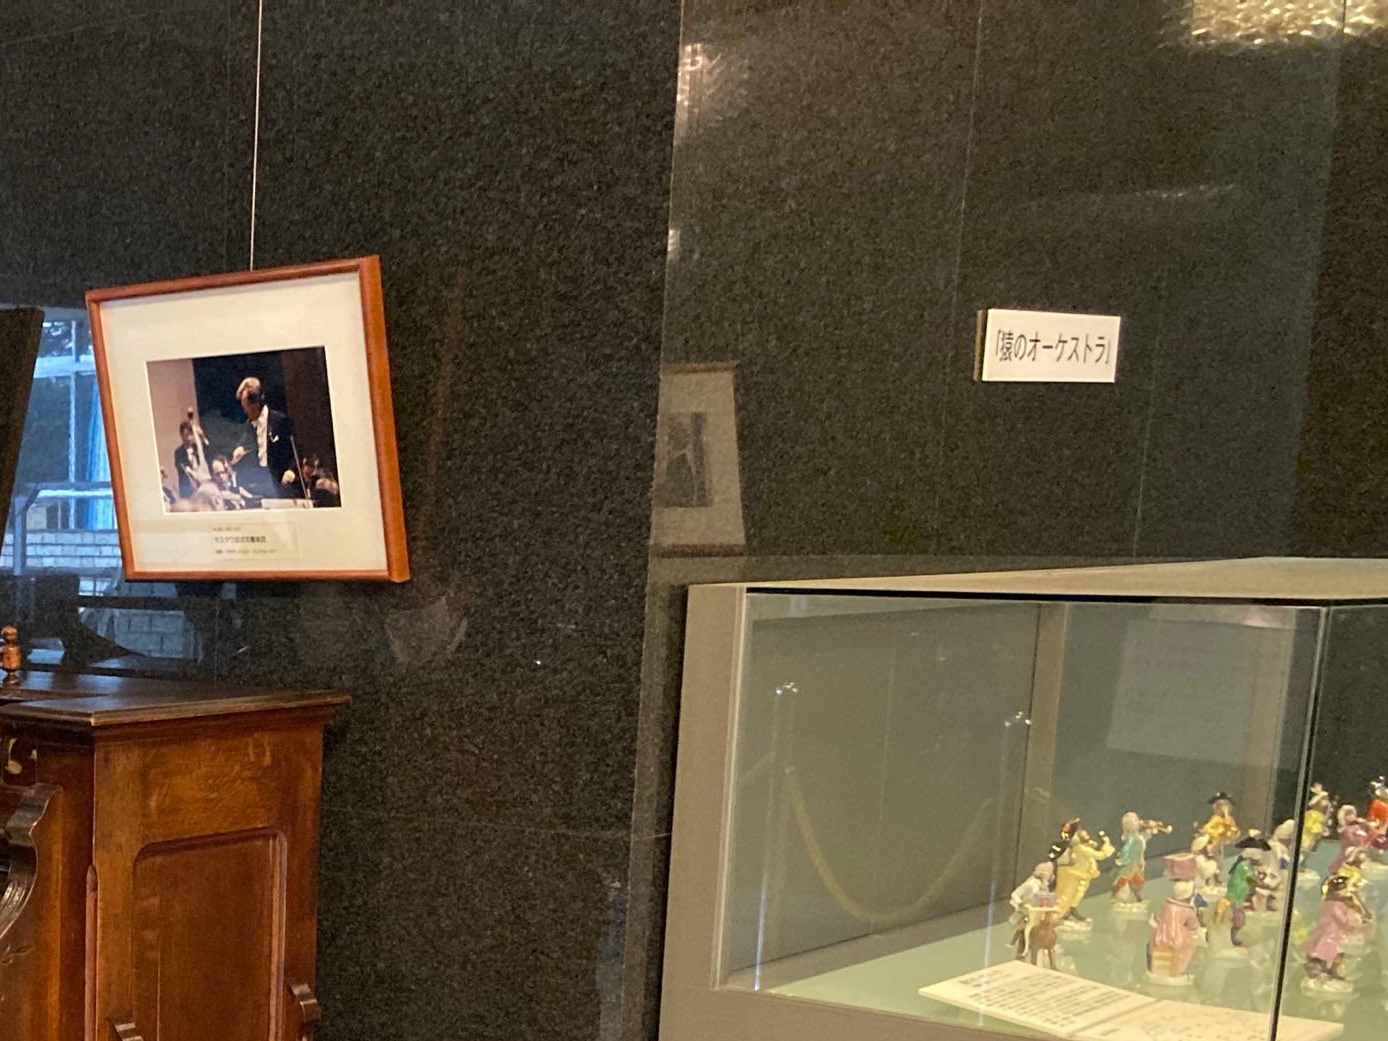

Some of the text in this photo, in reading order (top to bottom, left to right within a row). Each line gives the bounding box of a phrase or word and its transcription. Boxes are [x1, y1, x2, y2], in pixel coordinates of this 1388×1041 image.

[996, 329, 1111, 364] 「猿のオーケストラ」
